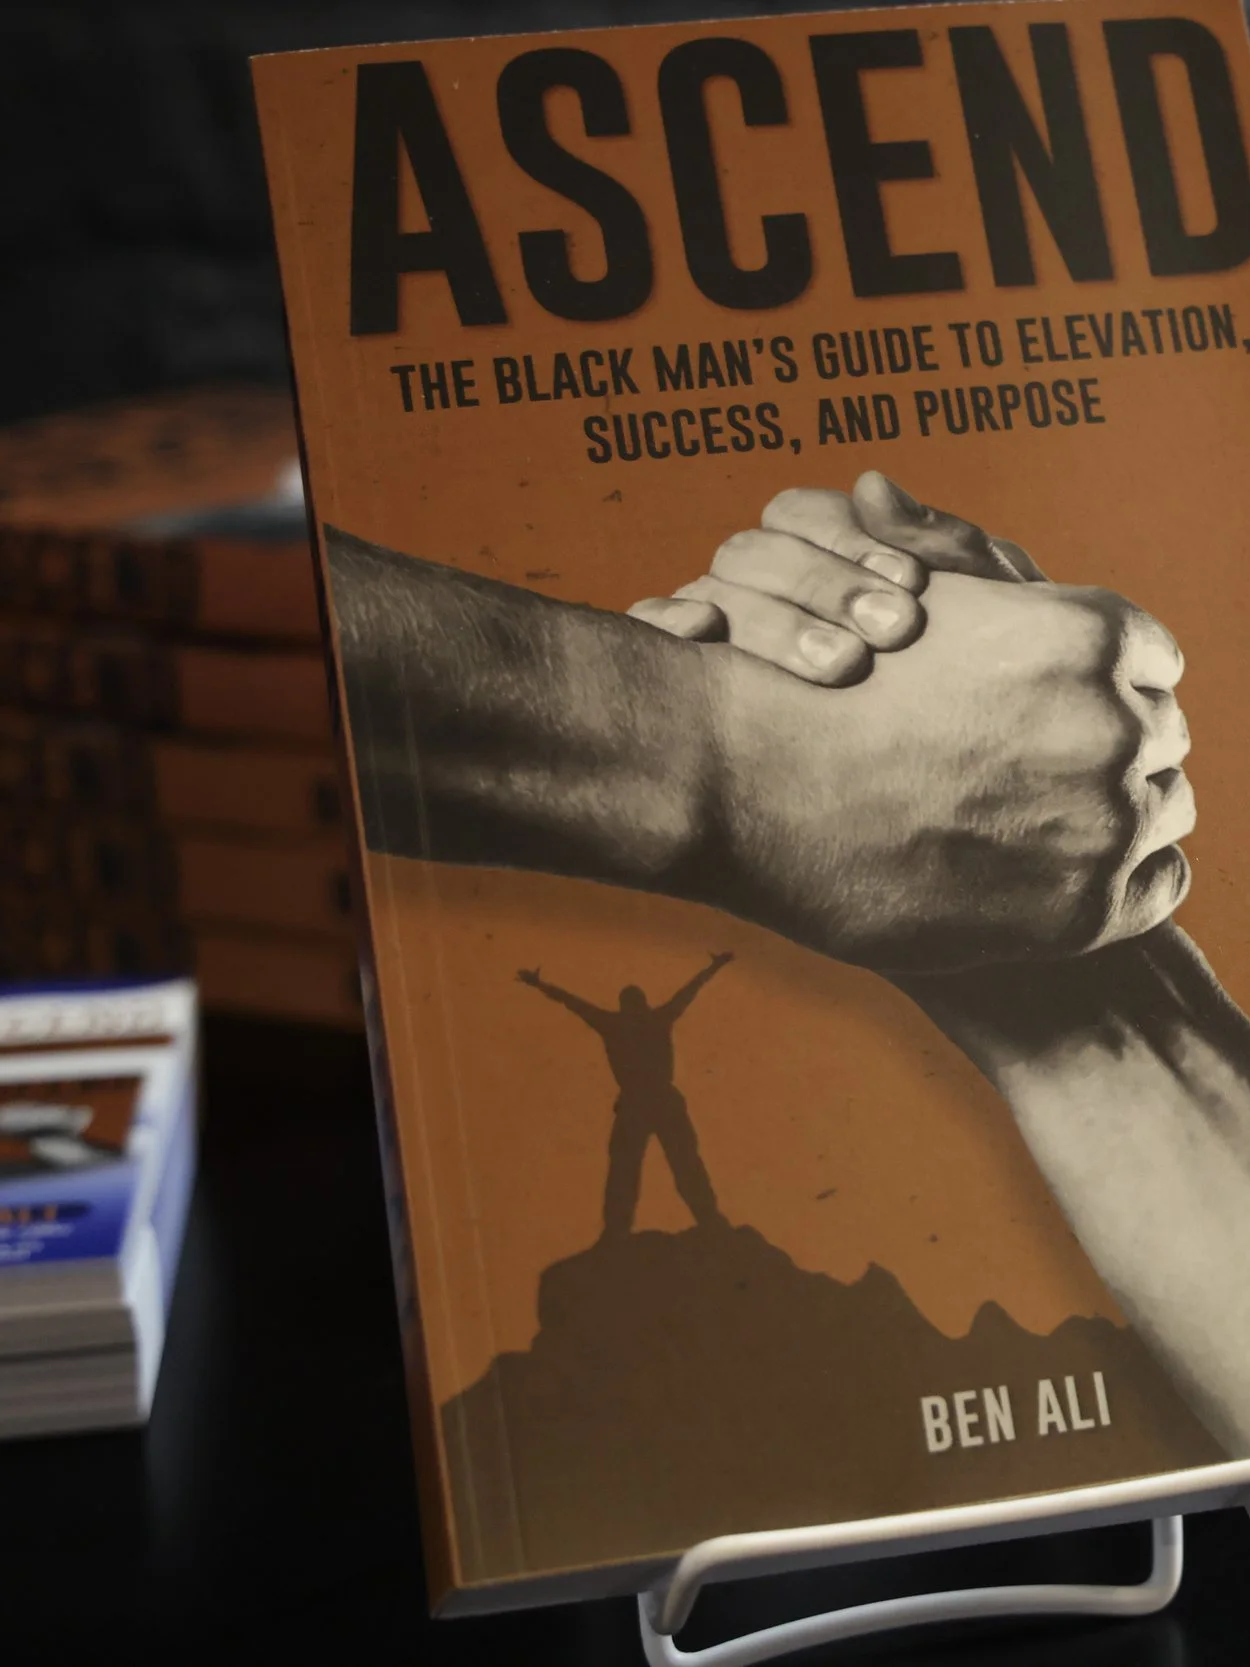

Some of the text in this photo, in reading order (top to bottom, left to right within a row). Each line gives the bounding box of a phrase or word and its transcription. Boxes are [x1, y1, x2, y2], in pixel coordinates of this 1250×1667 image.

[390, 358, 480, 413] THE
[493, 347, 639, 405] BLACK
[653, 335, 799, 392] MAN'S
[812, 325, 940, 380] GUIDE
[948, 320, 1004, 369] TO
[583, 378, 1106, 464] SUCCESS, AND PURPOSE
[920, 1371, 1112, 1453] BEN ALI
